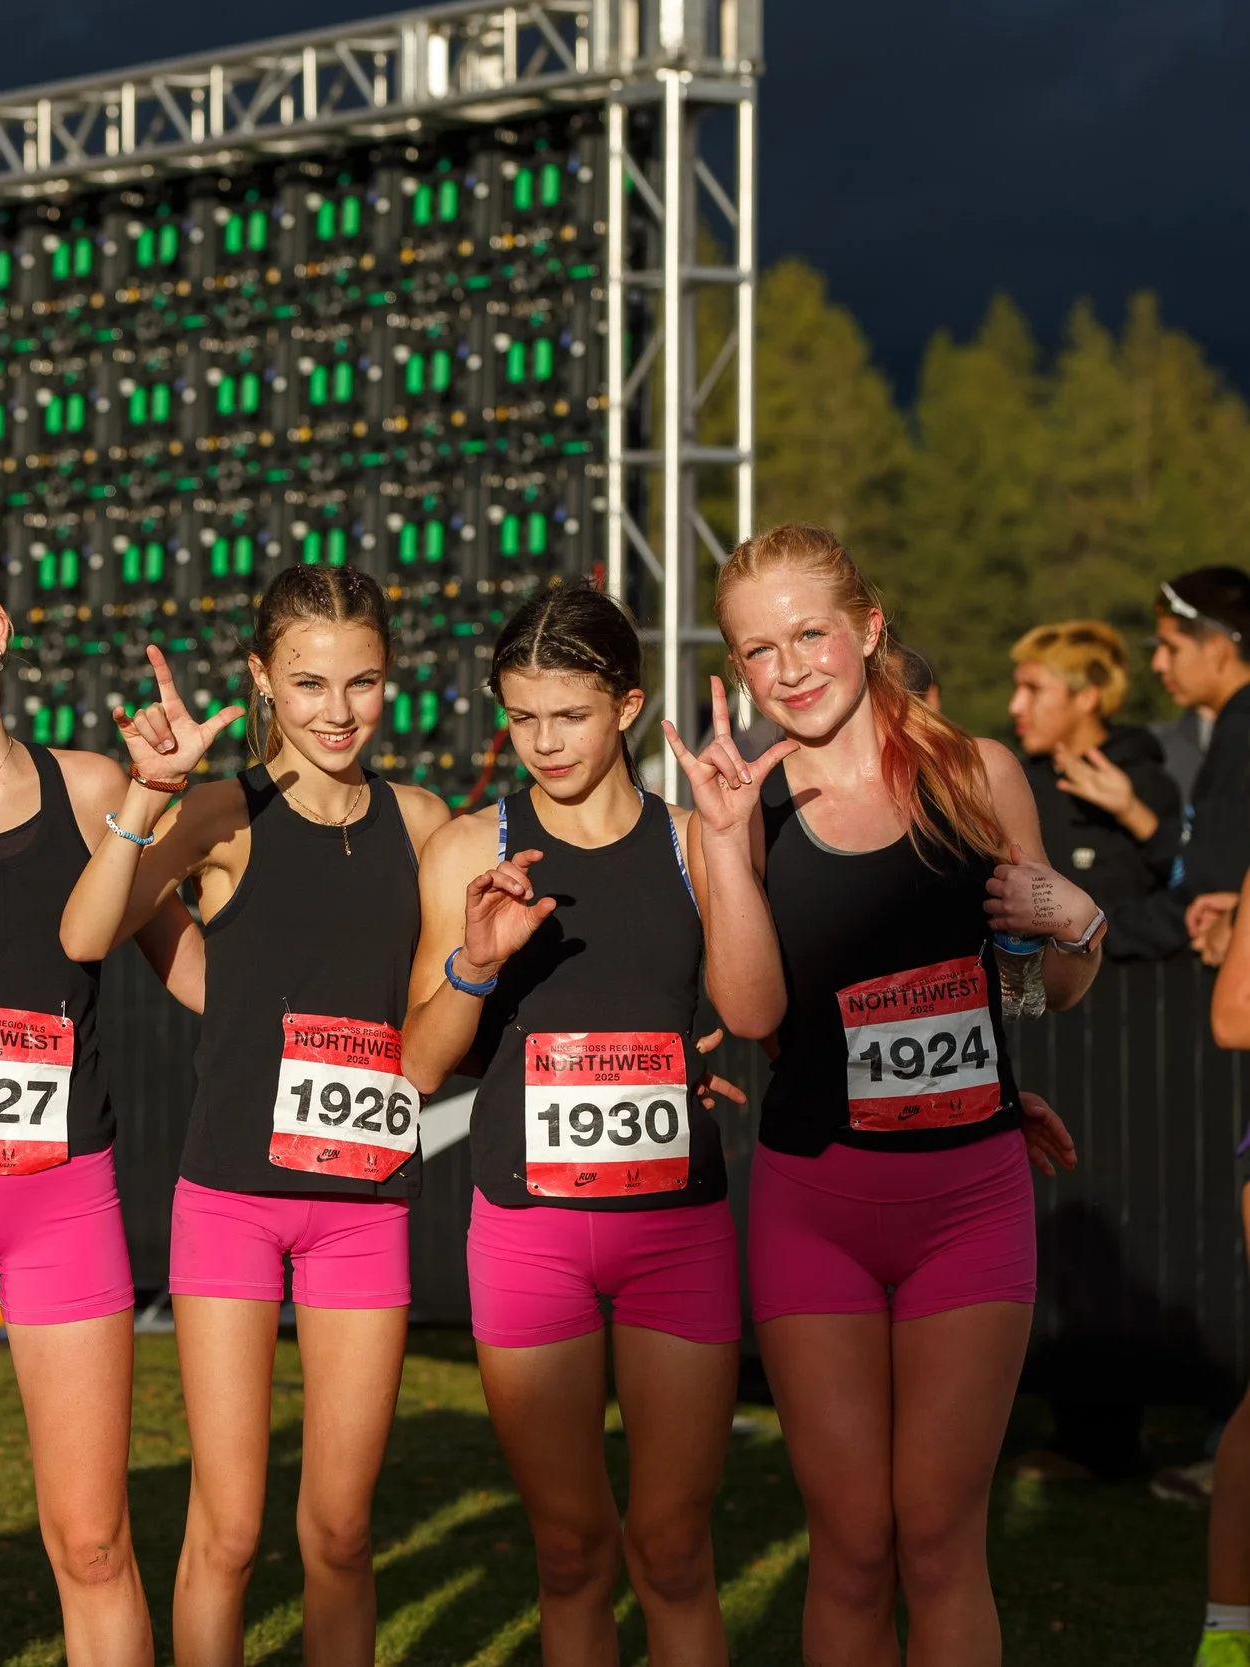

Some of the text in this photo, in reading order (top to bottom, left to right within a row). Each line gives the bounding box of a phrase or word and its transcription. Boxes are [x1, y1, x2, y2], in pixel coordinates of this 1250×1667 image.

[848, 978, 979, 1013] NORTHWEST
[910, 1004, 934, 1015] 2025
[294, 1030, 402, 1060] NORTHWES
[610, 1044, 659, 1052] REGIONALS
[347, 1055, 370, 1065] 2025
[859, 1025, 990, 1082] 1924
[535, 1054, 674, 1071] NORTHWEST
[594, 1073, 620, 1081] 2025
[290, 1079, 412, 1136] 1926
[537, 1099, 679, 1147] 1930
[321, 1149, 341, 1158] RUN
[579, 1172, 598, 1181] RUN
